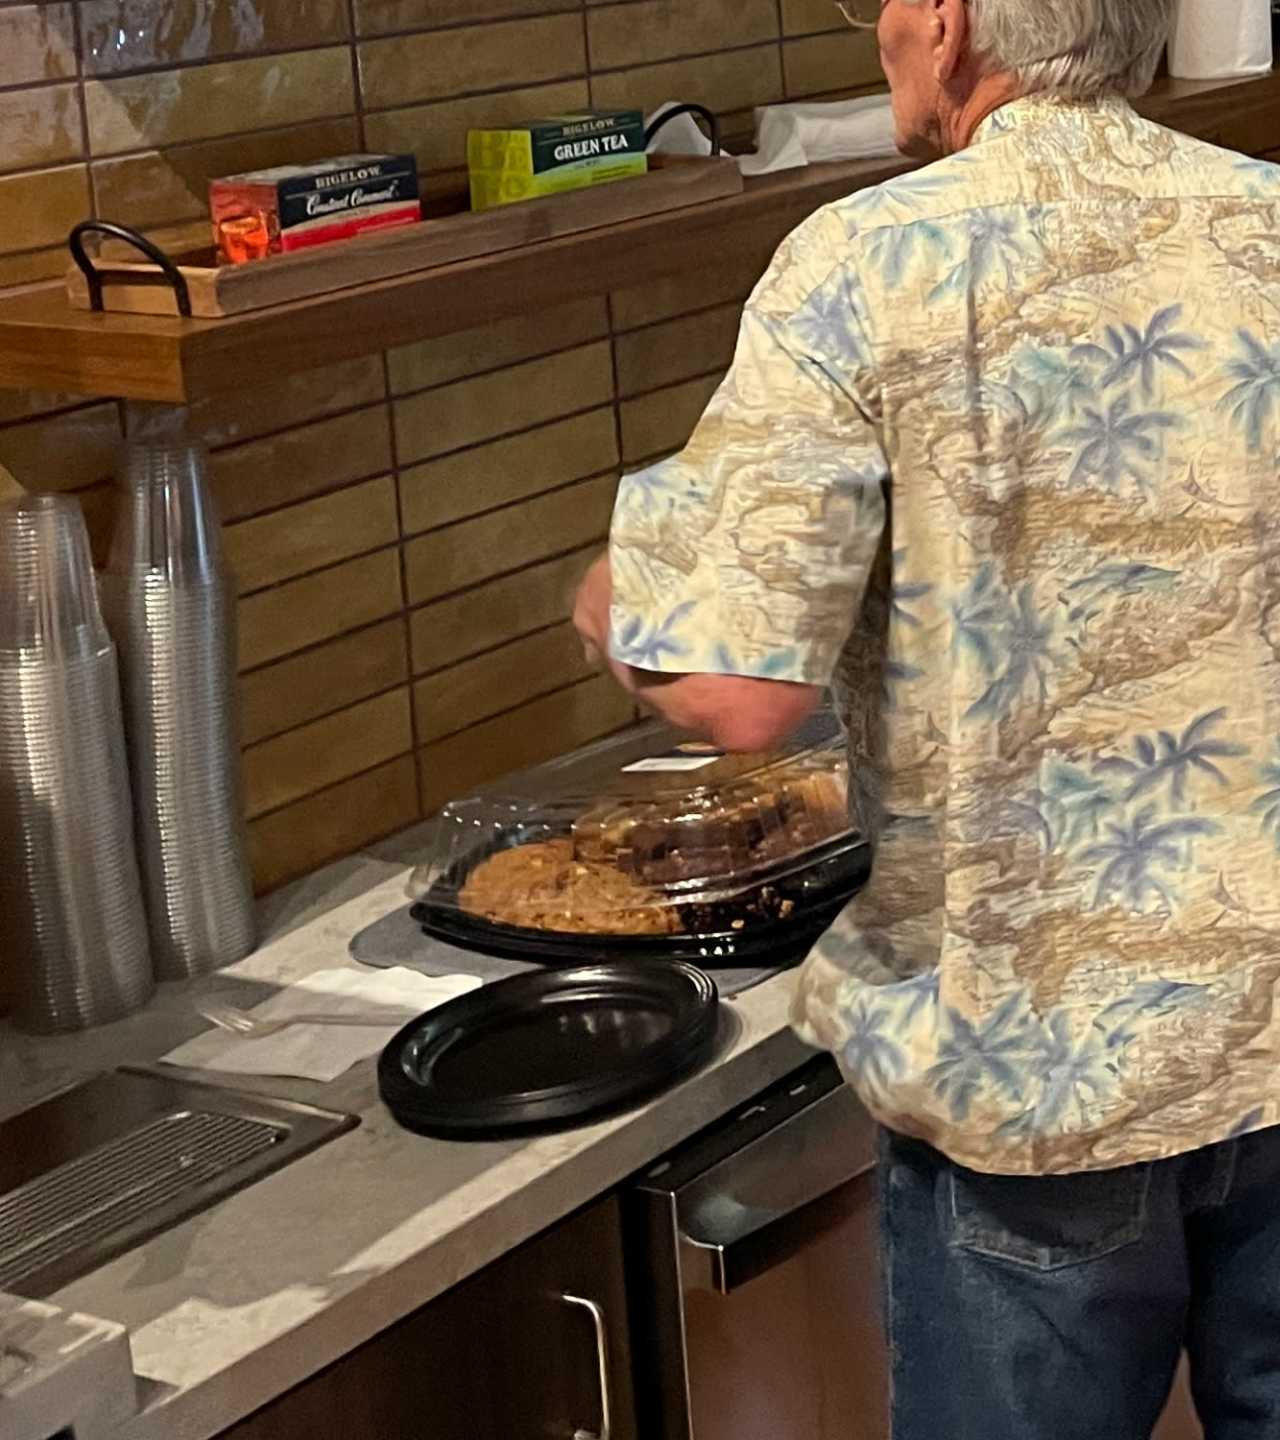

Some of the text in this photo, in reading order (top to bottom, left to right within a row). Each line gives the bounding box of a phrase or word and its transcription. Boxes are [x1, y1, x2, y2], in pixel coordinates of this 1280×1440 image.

[561, 117, 616, 137] BIGELOW
[553, 133, 629, 161] GREEN TEA
[314, 165, 382, 190] BIGELOW
